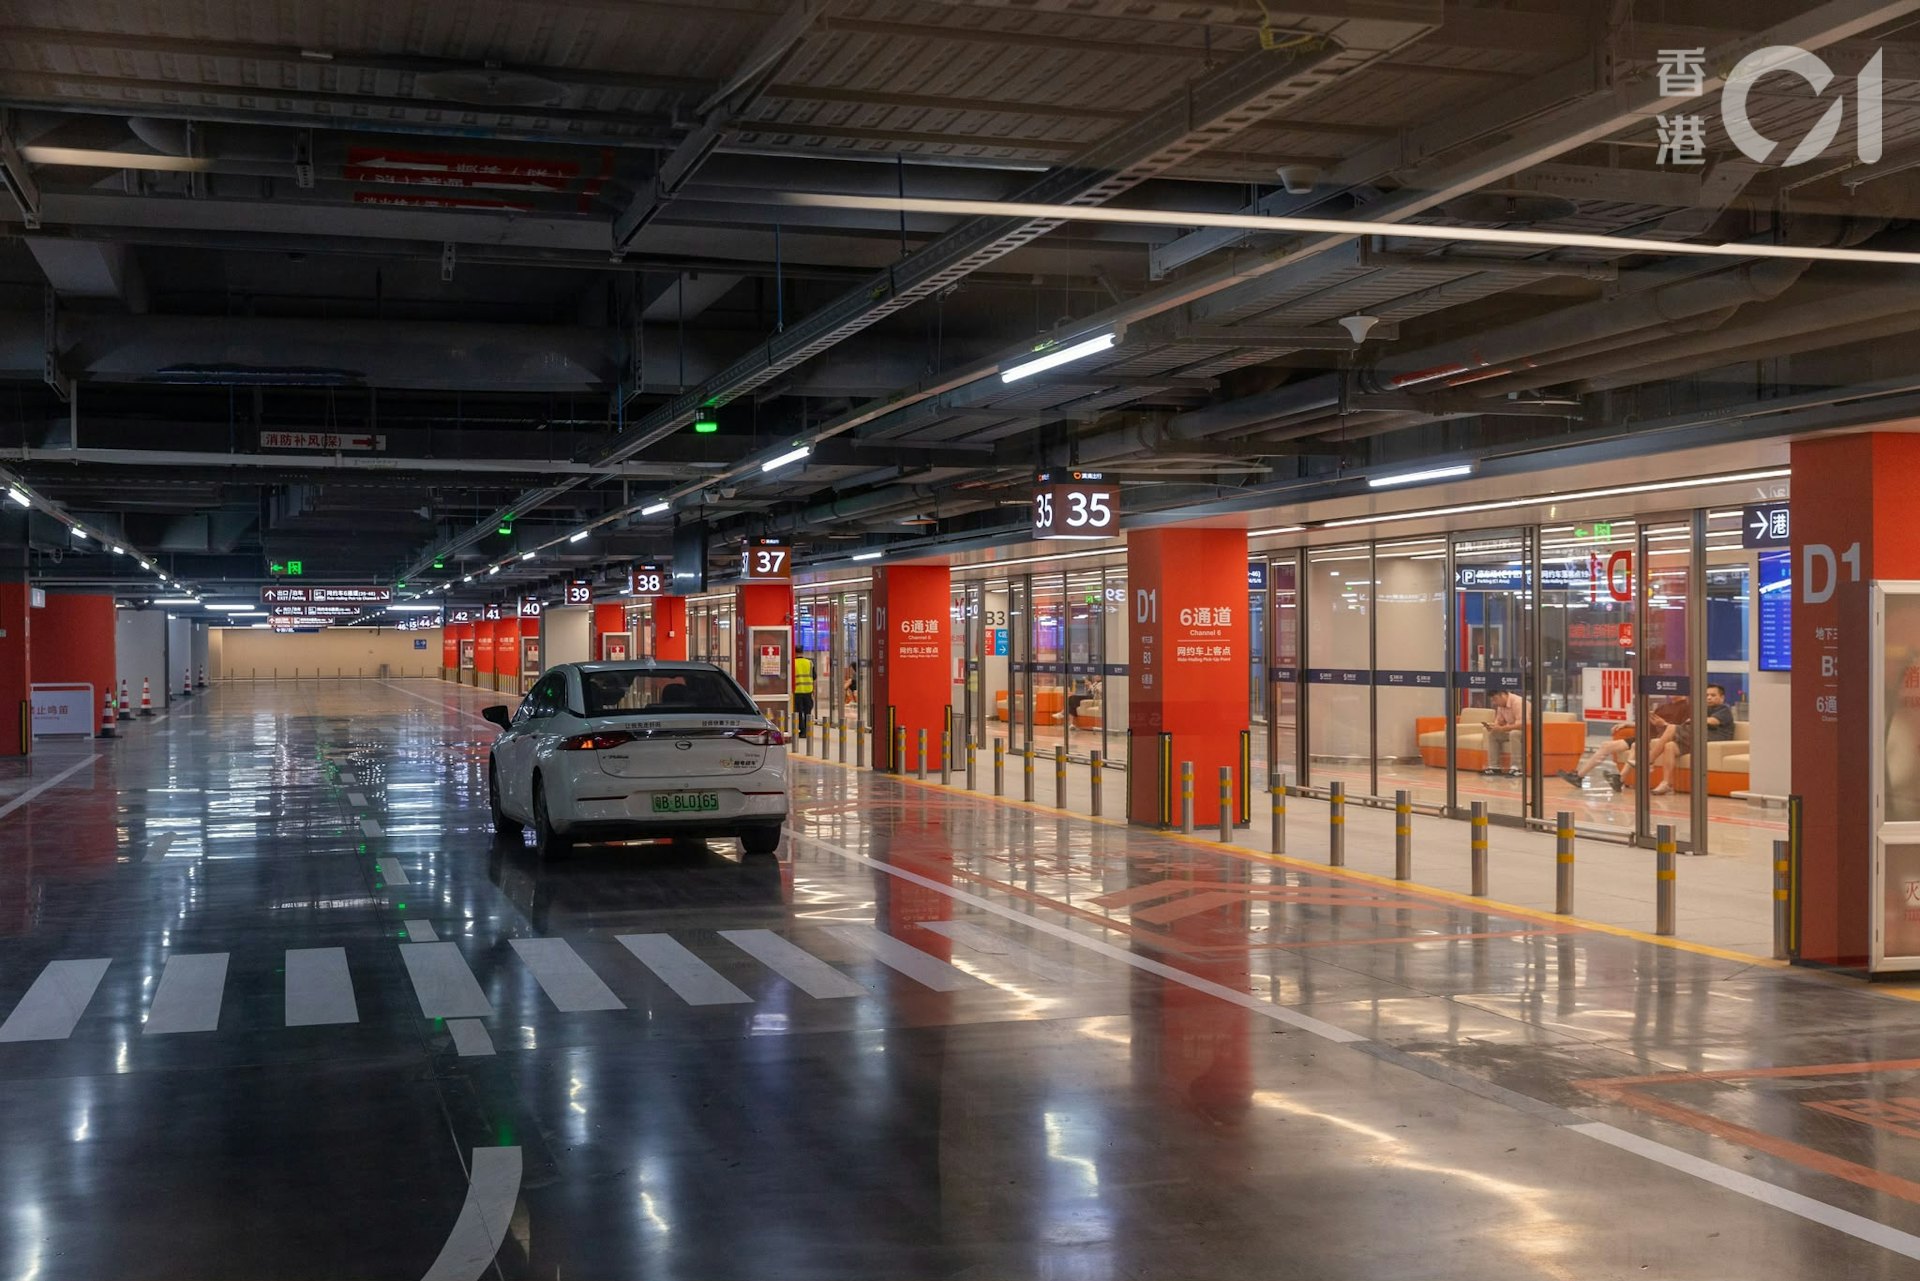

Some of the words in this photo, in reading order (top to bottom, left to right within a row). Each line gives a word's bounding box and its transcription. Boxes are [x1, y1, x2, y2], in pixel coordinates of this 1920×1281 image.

[1036, 492, 1053, 528] 35
[1066, 491, 1111, 527] 35
[1772, 514, 1787, 535] 港
[756, 551, 786, 573] 37
[1803, 542, 1861, 604] D1
[637, 574, 660, 592] 38
[570, 587, 590, 602] 39
[522, 603, 540, 615] 40
[1137, 588, 1156, 623] D1
[455, 612, 468, 621] 42
[486, 609, 501, 620] 41
[876, 607, 886, 631] D1
[986, 611, 1006, 626] B3
[1180, 607, 1232, 627] 6通道
[420, 619, 430, 627] 44
[901, 619, 939, 634] 6通道
[899, 647, 939, 655] 网约车上客点
[1177, 646, 1231, 657] 网约车上客点
